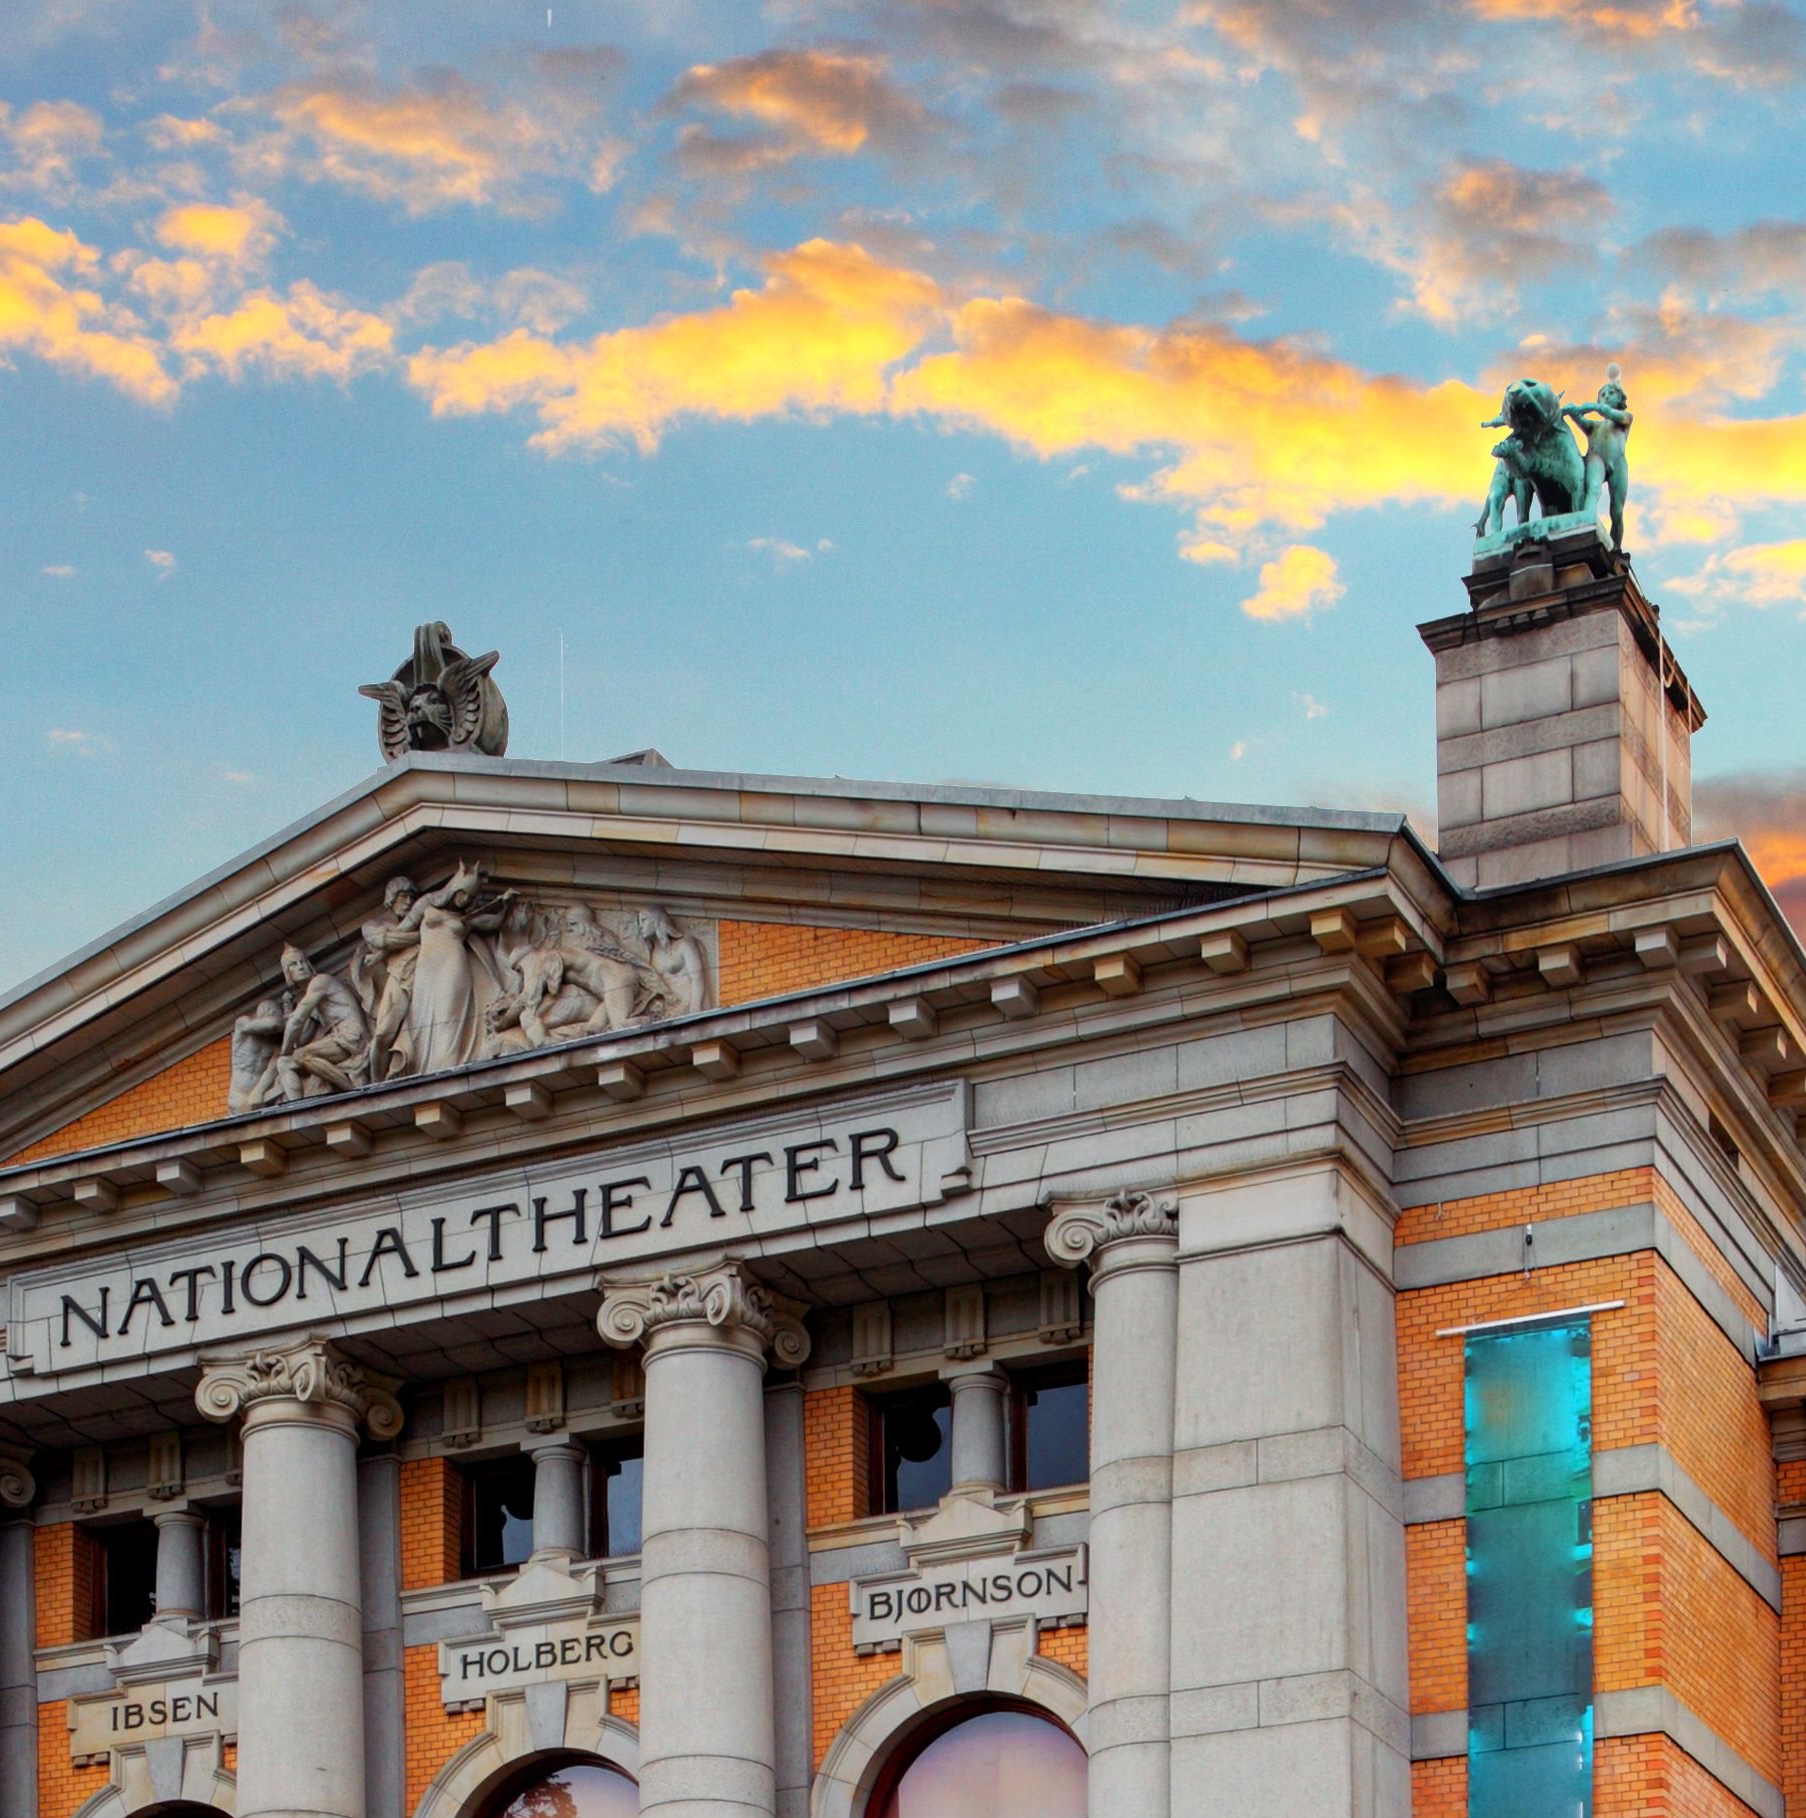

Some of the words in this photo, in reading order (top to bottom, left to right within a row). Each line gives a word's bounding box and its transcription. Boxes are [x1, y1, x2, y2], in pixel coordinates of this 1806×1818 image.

[59, 1126, 906, 1347] NATIONALTHEATER
[868, 1565, 1073, 1624] BJØRNSON
[461, 1630, 634, 1680] HOLBERG
[111, 1692, 219, 1731] IBSEN
